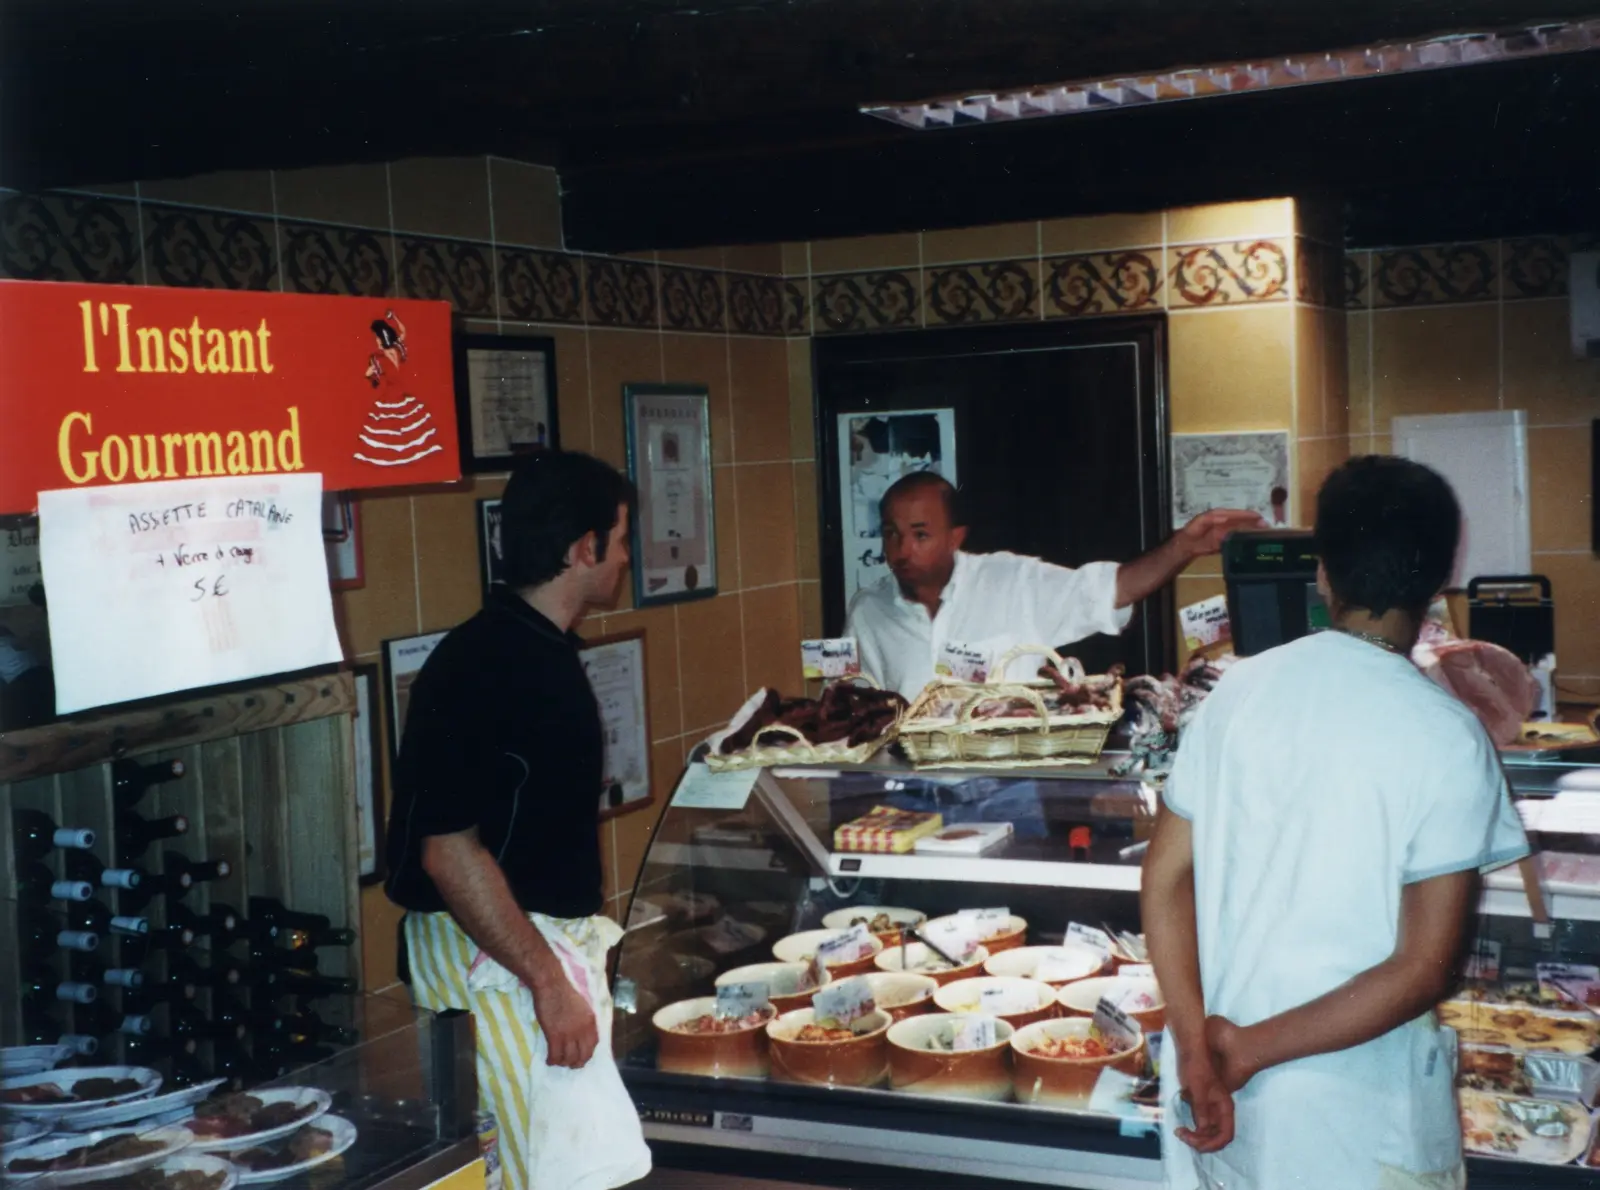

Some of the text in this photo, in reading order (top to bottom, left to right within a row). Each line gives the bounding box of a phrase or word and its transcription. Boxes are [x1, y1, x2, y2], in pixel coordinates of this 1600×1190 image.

[79, 300, 274, 373] l'Instant
[58, 405, 304, 484] Gourmand
[226, 498, 294, 524] CATALANE
